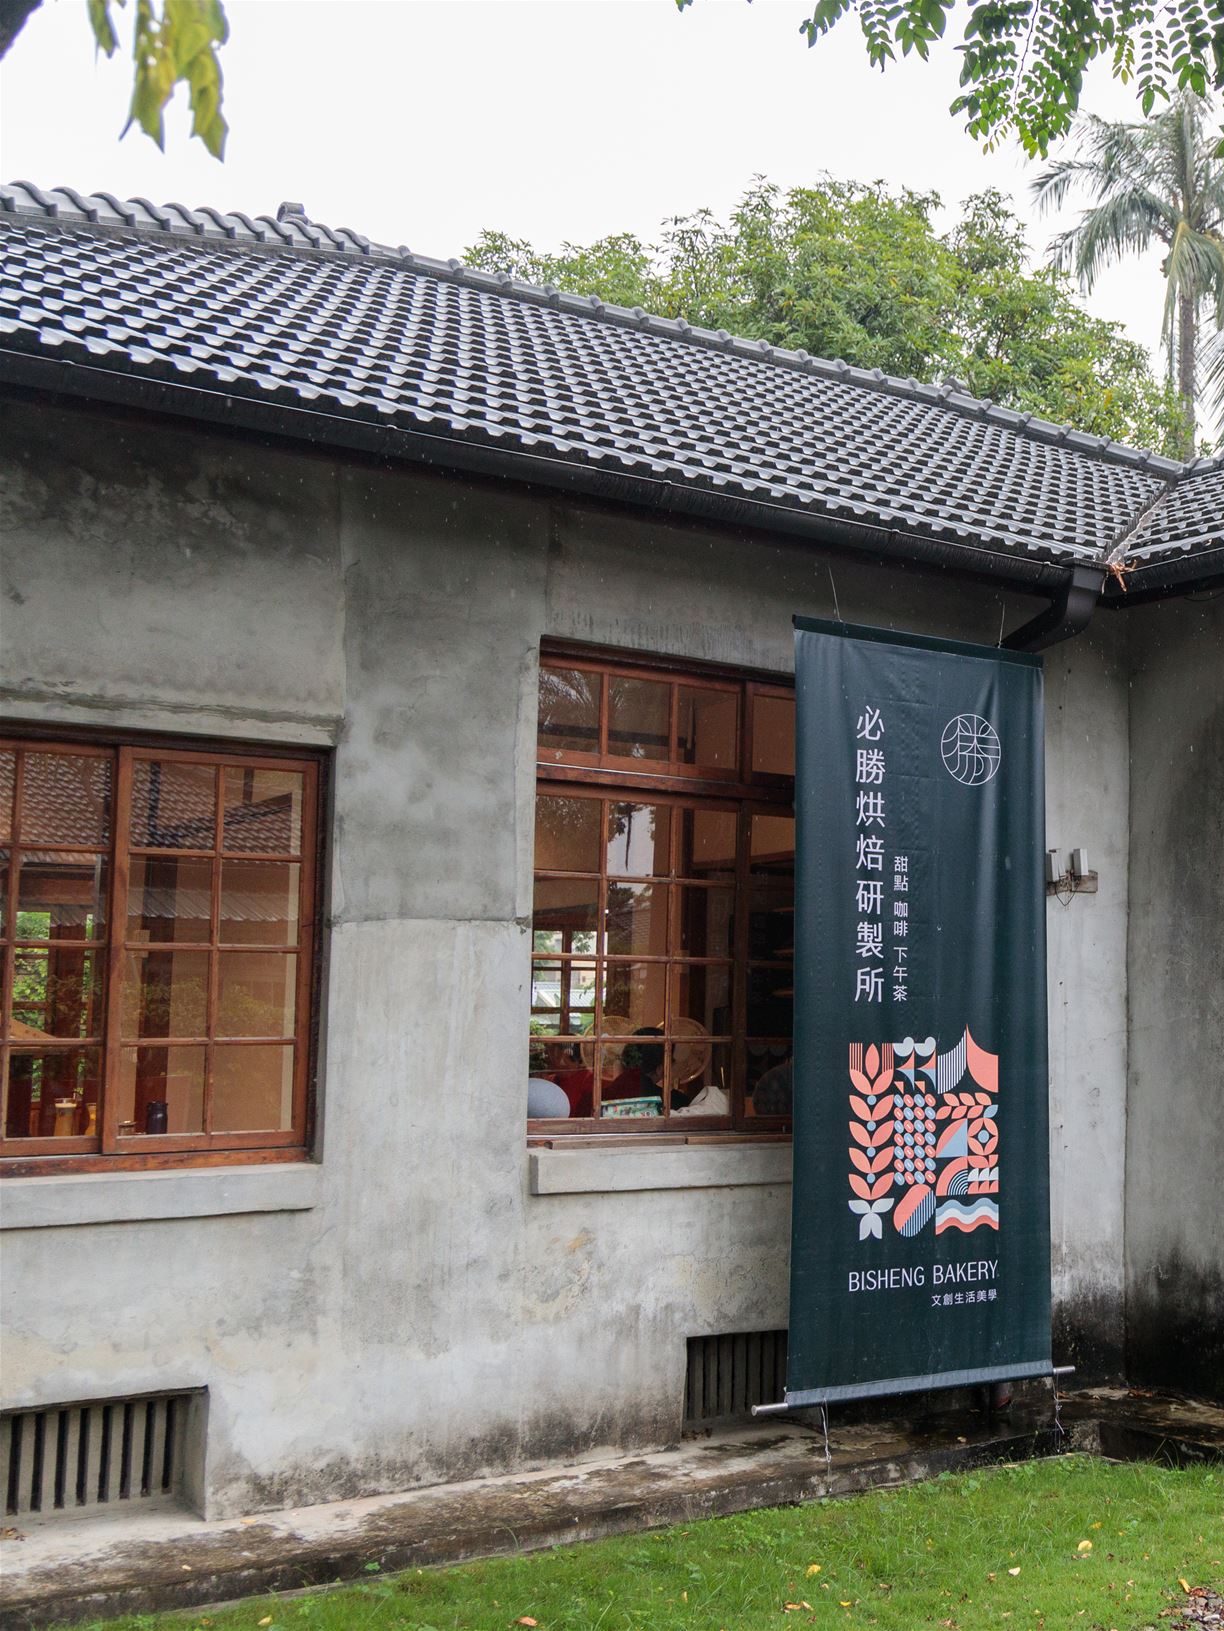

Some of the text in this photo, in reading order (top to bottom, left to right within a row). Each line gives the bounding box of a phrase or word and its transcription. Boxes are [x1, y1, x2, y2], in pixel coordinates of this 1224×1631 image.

[854, 705, 886, 1003] 必勝烘焙研製所
[892, 855, 909, 1002] 甜點 咖啡 下午茶
[849, 1259, 998, 1292] BISHENG BAKERY
[931, 1288, 998, 1307] 文創生活美學
